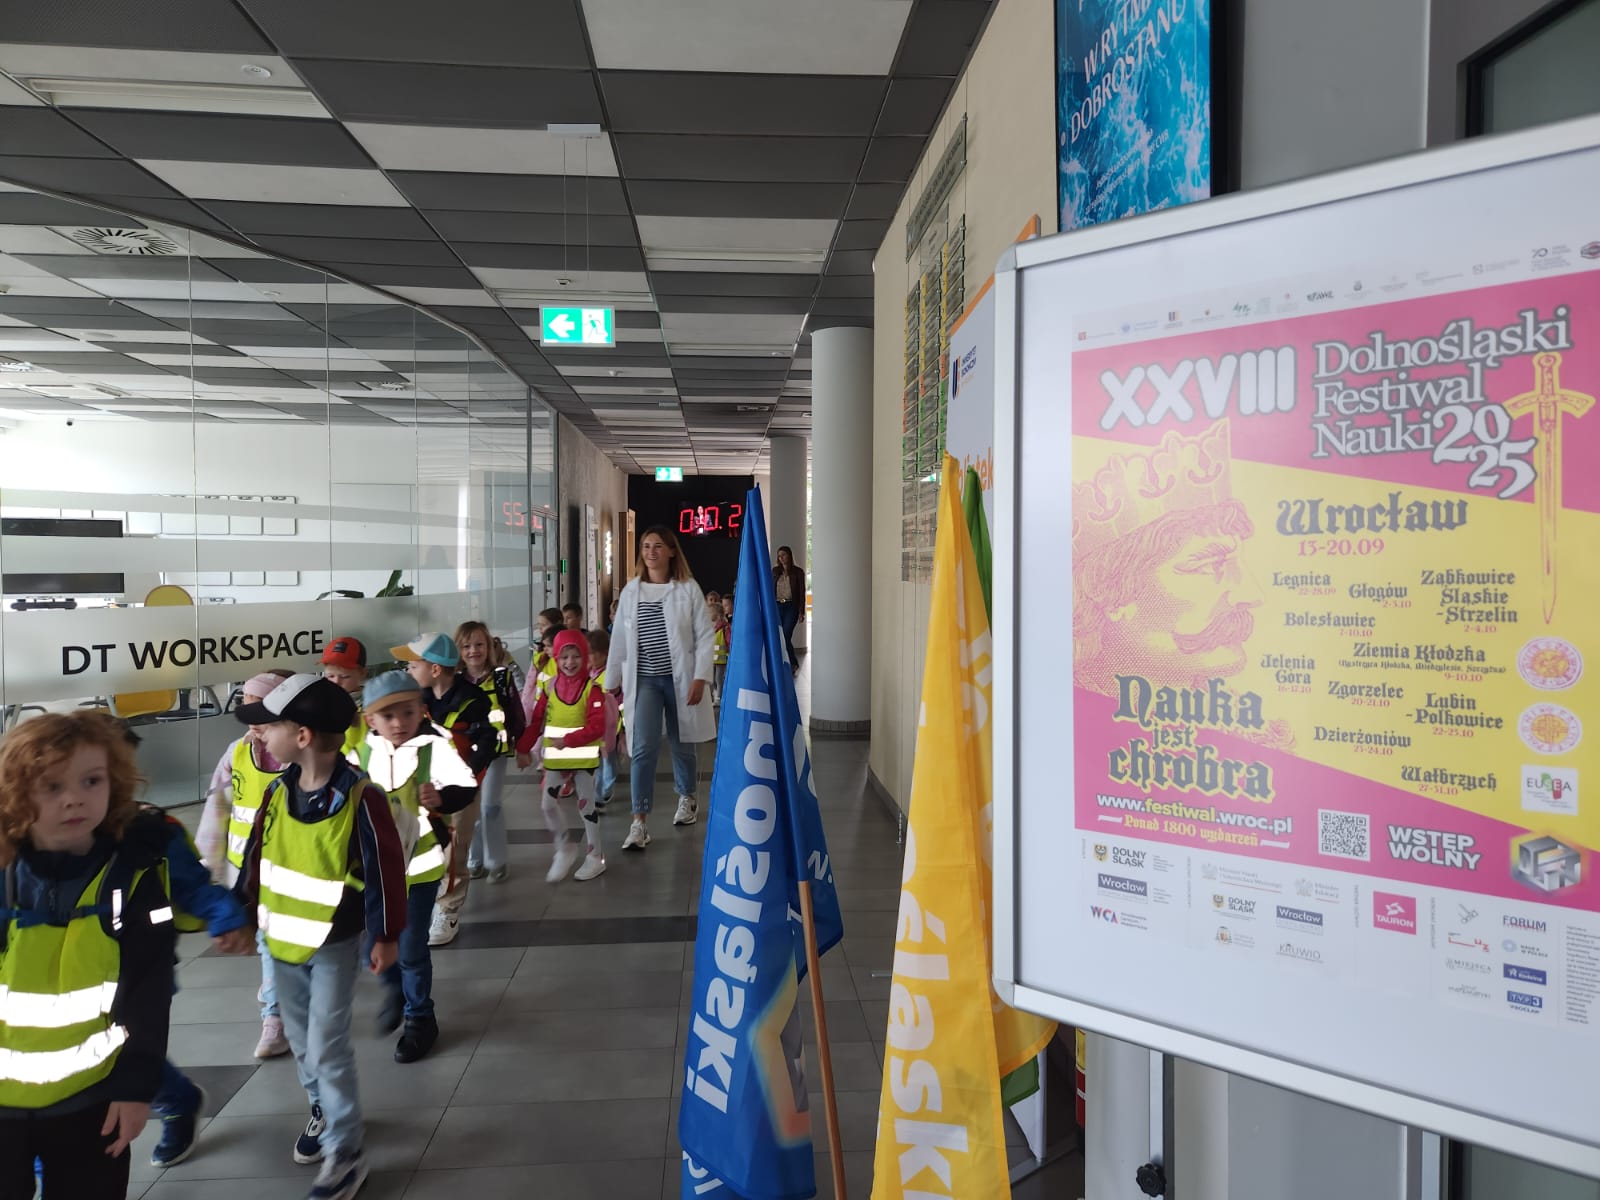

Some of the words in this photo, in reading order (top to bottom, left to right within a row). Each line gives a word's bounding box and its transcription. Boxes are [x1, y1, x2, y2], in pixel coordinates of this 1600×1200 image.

[1313, 306, 1571, 378] Dolnośląski
[1100, 346, 1296, 431] XXVIII
[1313, 362, 1487, 418] Festiwal
[1312, 410, 1434, 458] Nauki
[1276, 491, 1468, 536] Wrocław
[1272, 571, 1331, 590] Legnica
[1420, 568, 1516, 587] Ząbkowice
[1348, 582, 1408, 602] Głogów
[1284, 611, 1376, 628] Bolesławiec
[62, 643, 116, 676] DT
[128, 629, 325, 670] WORKSPACE
[1260, 653, 1316, 670] Jelenia
[1352, 641, 1410, 659] Ziemia
[1414, 643, 1486, 663] Kłodzka
[1275, 668, 1312, 684] Góra
[1327, 680, 1404, 700] Zgorzelec
[1425, 692, 1477, 710] Lubin
[1113, 674, 1265, 730] Nauka
[1152, 722, 1195, 750] jest
[1313, 726, 1412, 748] Dzierżoniów
[1108, 738, 1275, 800] chrobra
[1401, 765, 1497, 792] Wałbrzych
[1096, 794, 1293, 835] www.festiwal.wroc.pl
[1124, 814, 1160, 831] Ponad
[1162, 820, 1197, 838] 1800
[1199, 826, 1259, 848] wydarzeń
[1112, 846, 1147, 860] DOLNY
[1387, 841, 1482, 871] WOLNY
[1228, 896, 1257, 907] DOLNY
[1090, 904, 1119, 924] WCA
[1375, 914, 1415, 929] TAURON
[1502, 914, 1547, 933] FORUM
